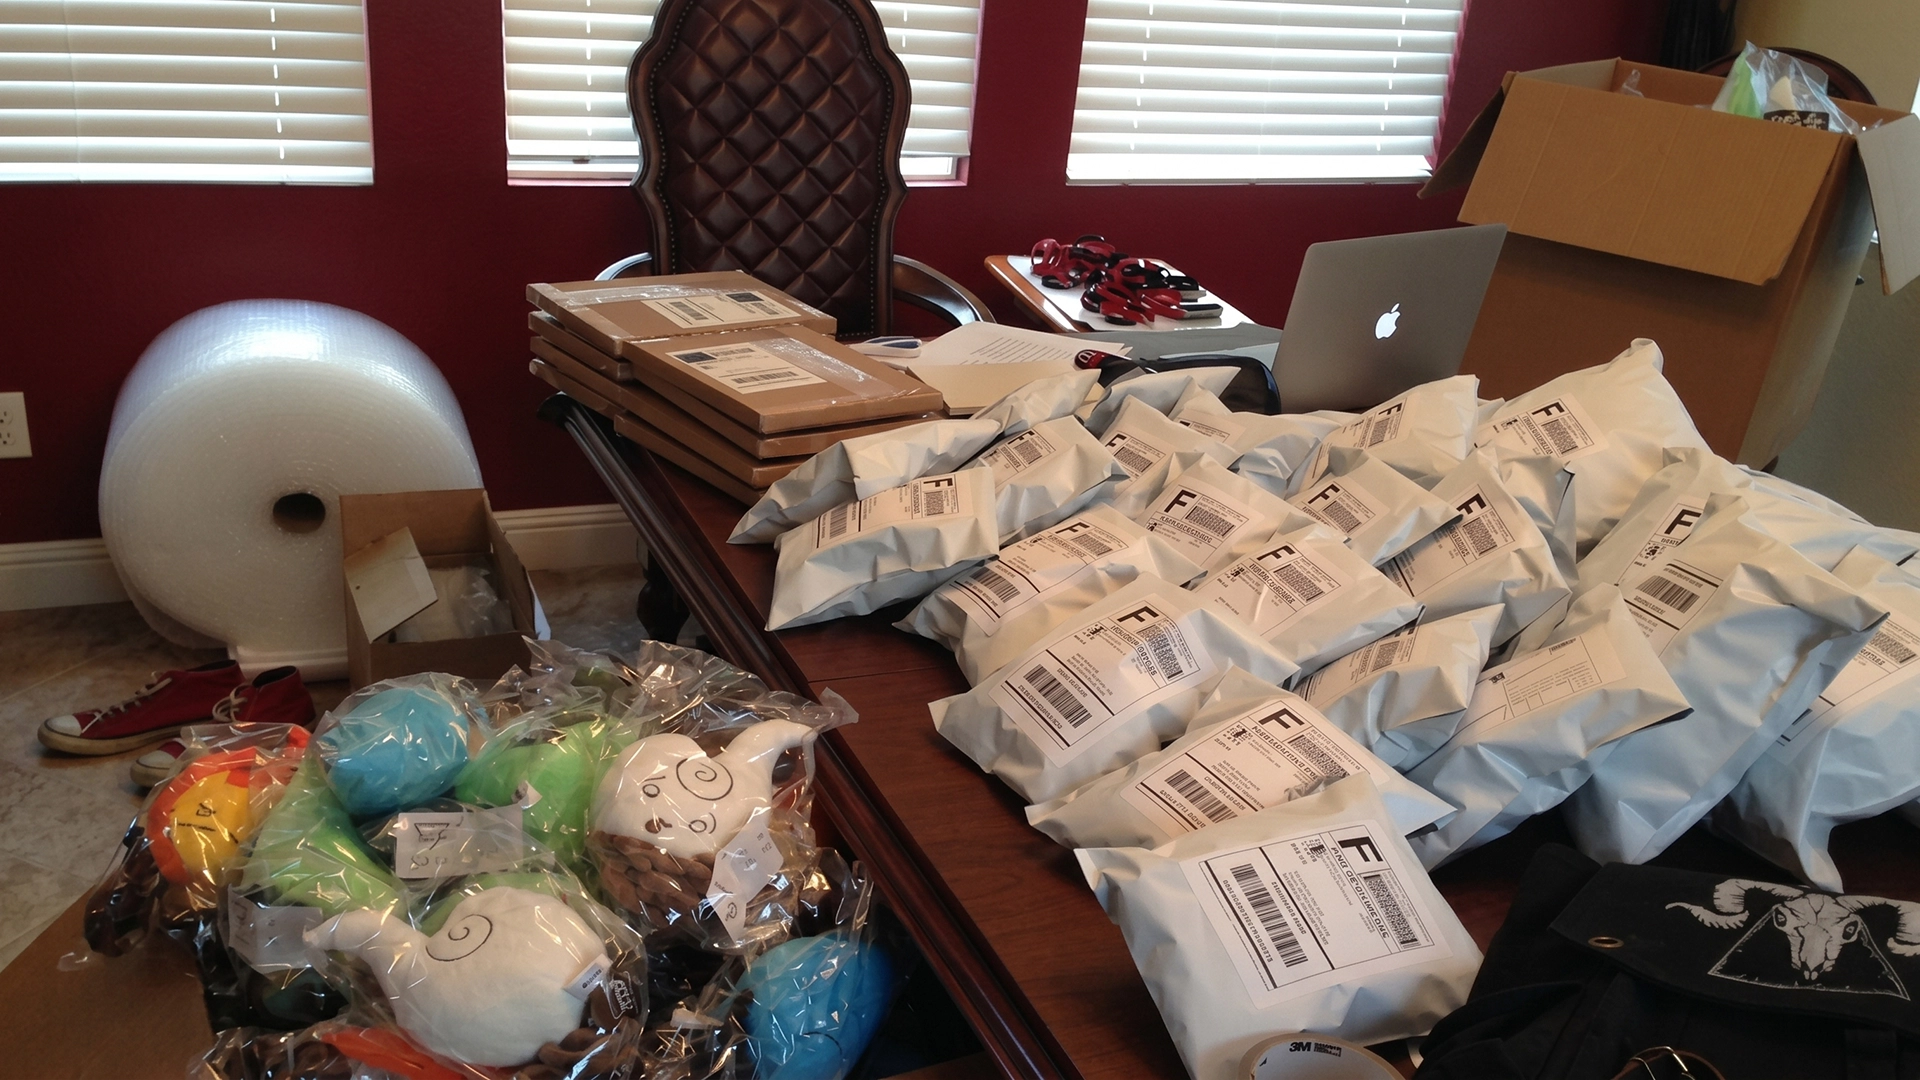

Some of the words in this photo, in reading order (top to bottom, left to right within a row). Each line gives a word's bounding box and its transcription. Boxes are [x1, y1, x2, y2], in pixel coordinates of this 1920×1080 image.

[1378, 402, 1402, 415] F
[1531, 402, 1565, 416] F
[1007, 430, 1036, 445] F
[1105, 433, 1127, 447] F
[923, 477, 953, 487] F
[1164, 489, 1197, 513] F
[1308, 483, 1340, 504] F
[1455, 493, 1487, 515] F
[1055, 521, 1091, 534] F
[1664, 509, 1702, 535] F
[1256, 545, 1296, 561] F
[1117, 606, 1159, 623] F
[1258, 708, 1305, 729] F
[1337, 836, 1384, 862] F
[1289, 1042, 1312, 1052] 3M
